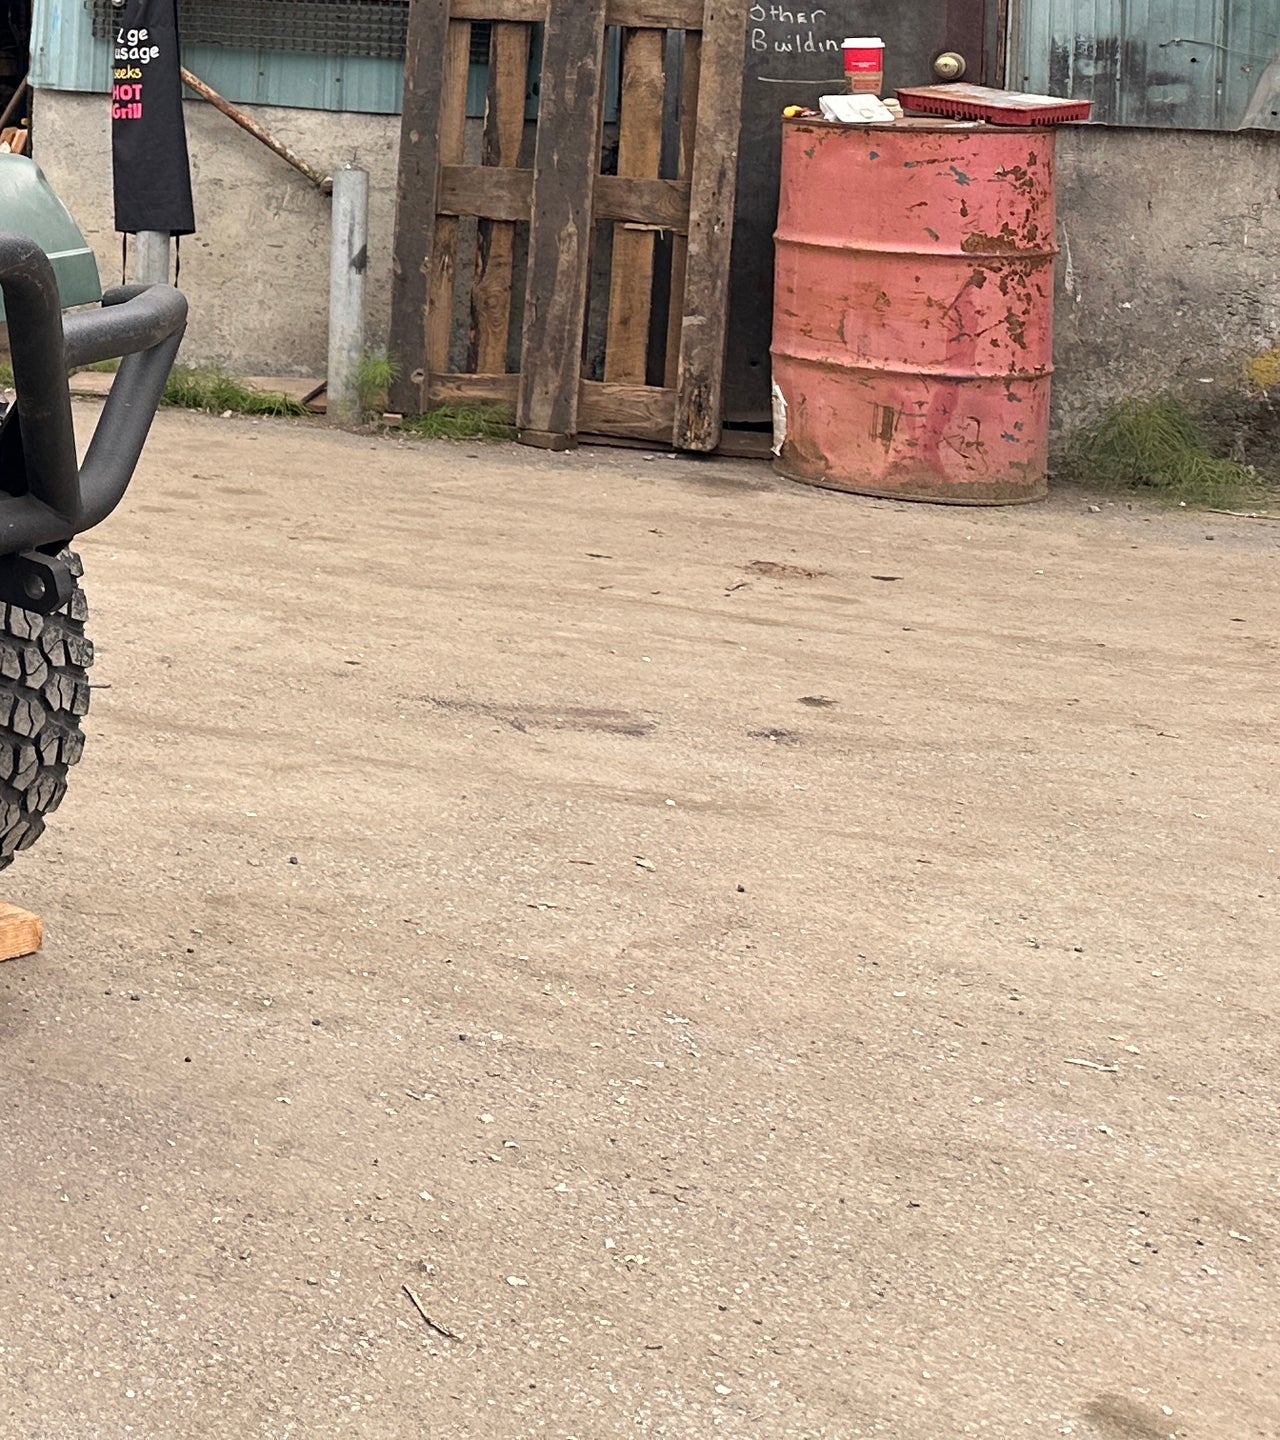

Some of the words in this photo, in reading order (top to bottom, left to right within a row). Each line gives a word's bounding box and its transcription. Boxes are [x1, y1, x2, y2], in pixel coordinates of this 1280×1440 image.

[752, 28, 839, 53] Buildin
[112, 84, 143, 100] HOT
[112, 102, 143, 119] Grill
